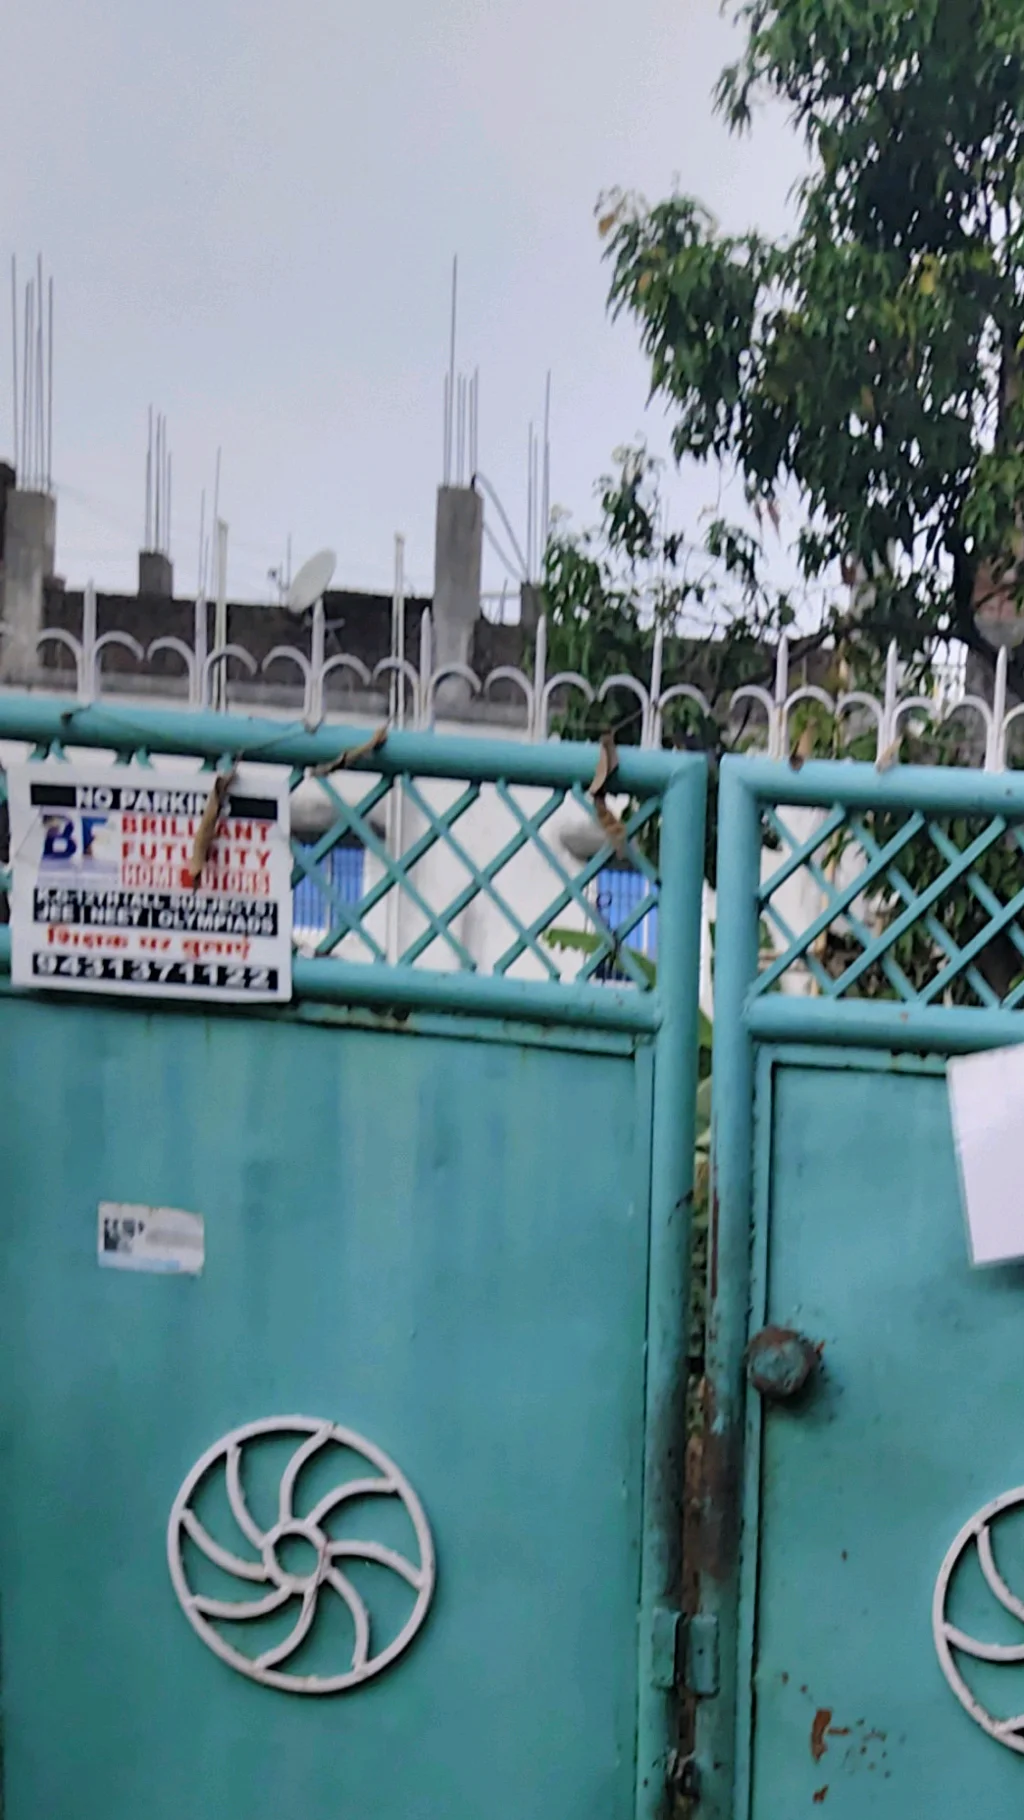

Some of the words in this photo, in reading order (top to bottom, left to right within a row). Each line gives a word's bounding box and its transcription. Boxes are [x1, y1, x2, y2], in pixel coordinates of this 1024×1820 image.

[78, 785, 113, 810] NO
[121, 815, 274, 842] BRILLANT
[180, 866, 269, 893] UTORS
[37, 904, 75, 923] JEE
[90, 904, 141, 926] NEET
[157, 909, 274, 935] OLYMPIADS
[36, 953, 270, 991] 9431371122
